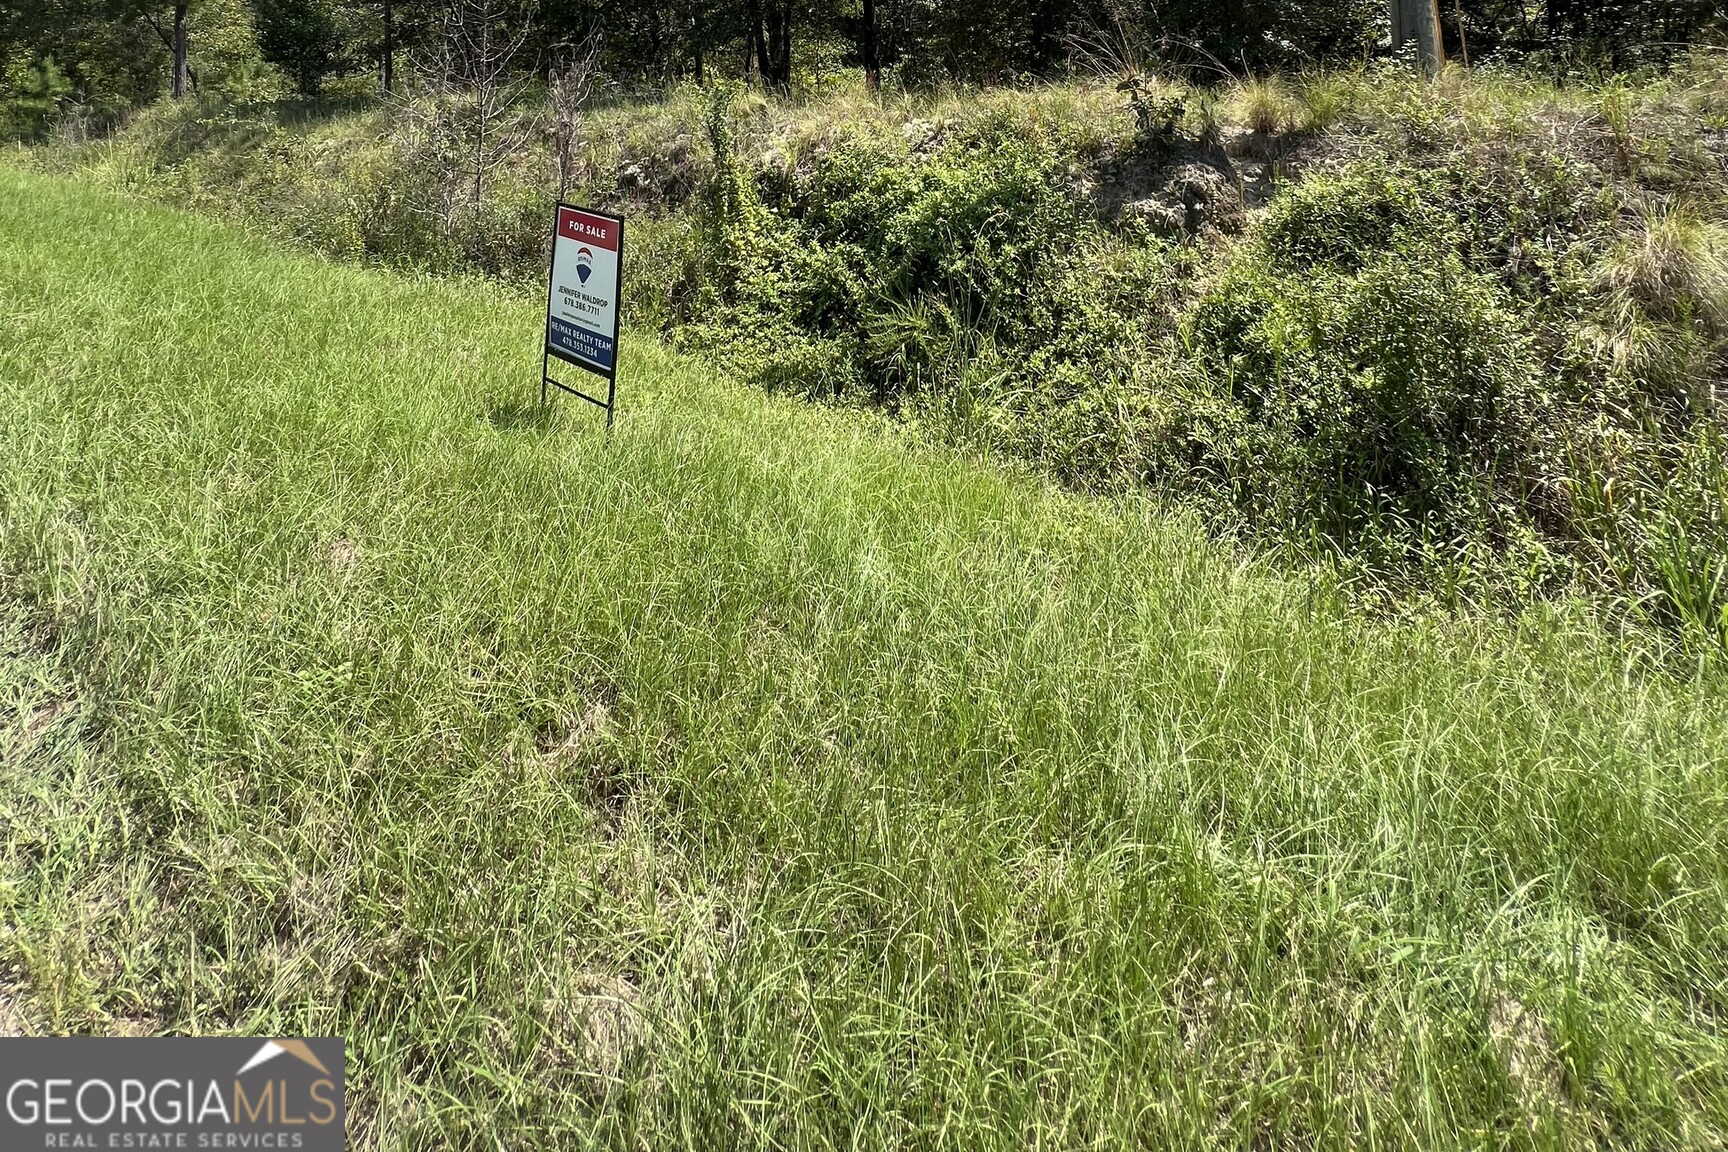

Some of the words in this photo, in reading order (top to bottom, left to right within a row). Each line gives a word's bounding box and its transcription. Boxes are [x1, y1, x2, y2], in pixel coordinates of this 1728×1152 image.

[569, 220, 584, 233] FOR
[586, 225, 607, 239] SALE
[558, 285, 581, 299] JENNIFER
[581, 293, 608, 308] WALDROP
[551, 321, 573, 336] RE/MAX
[572, 329, 594, 345] REALTY
[594, 338, 612, 352] TEAM
